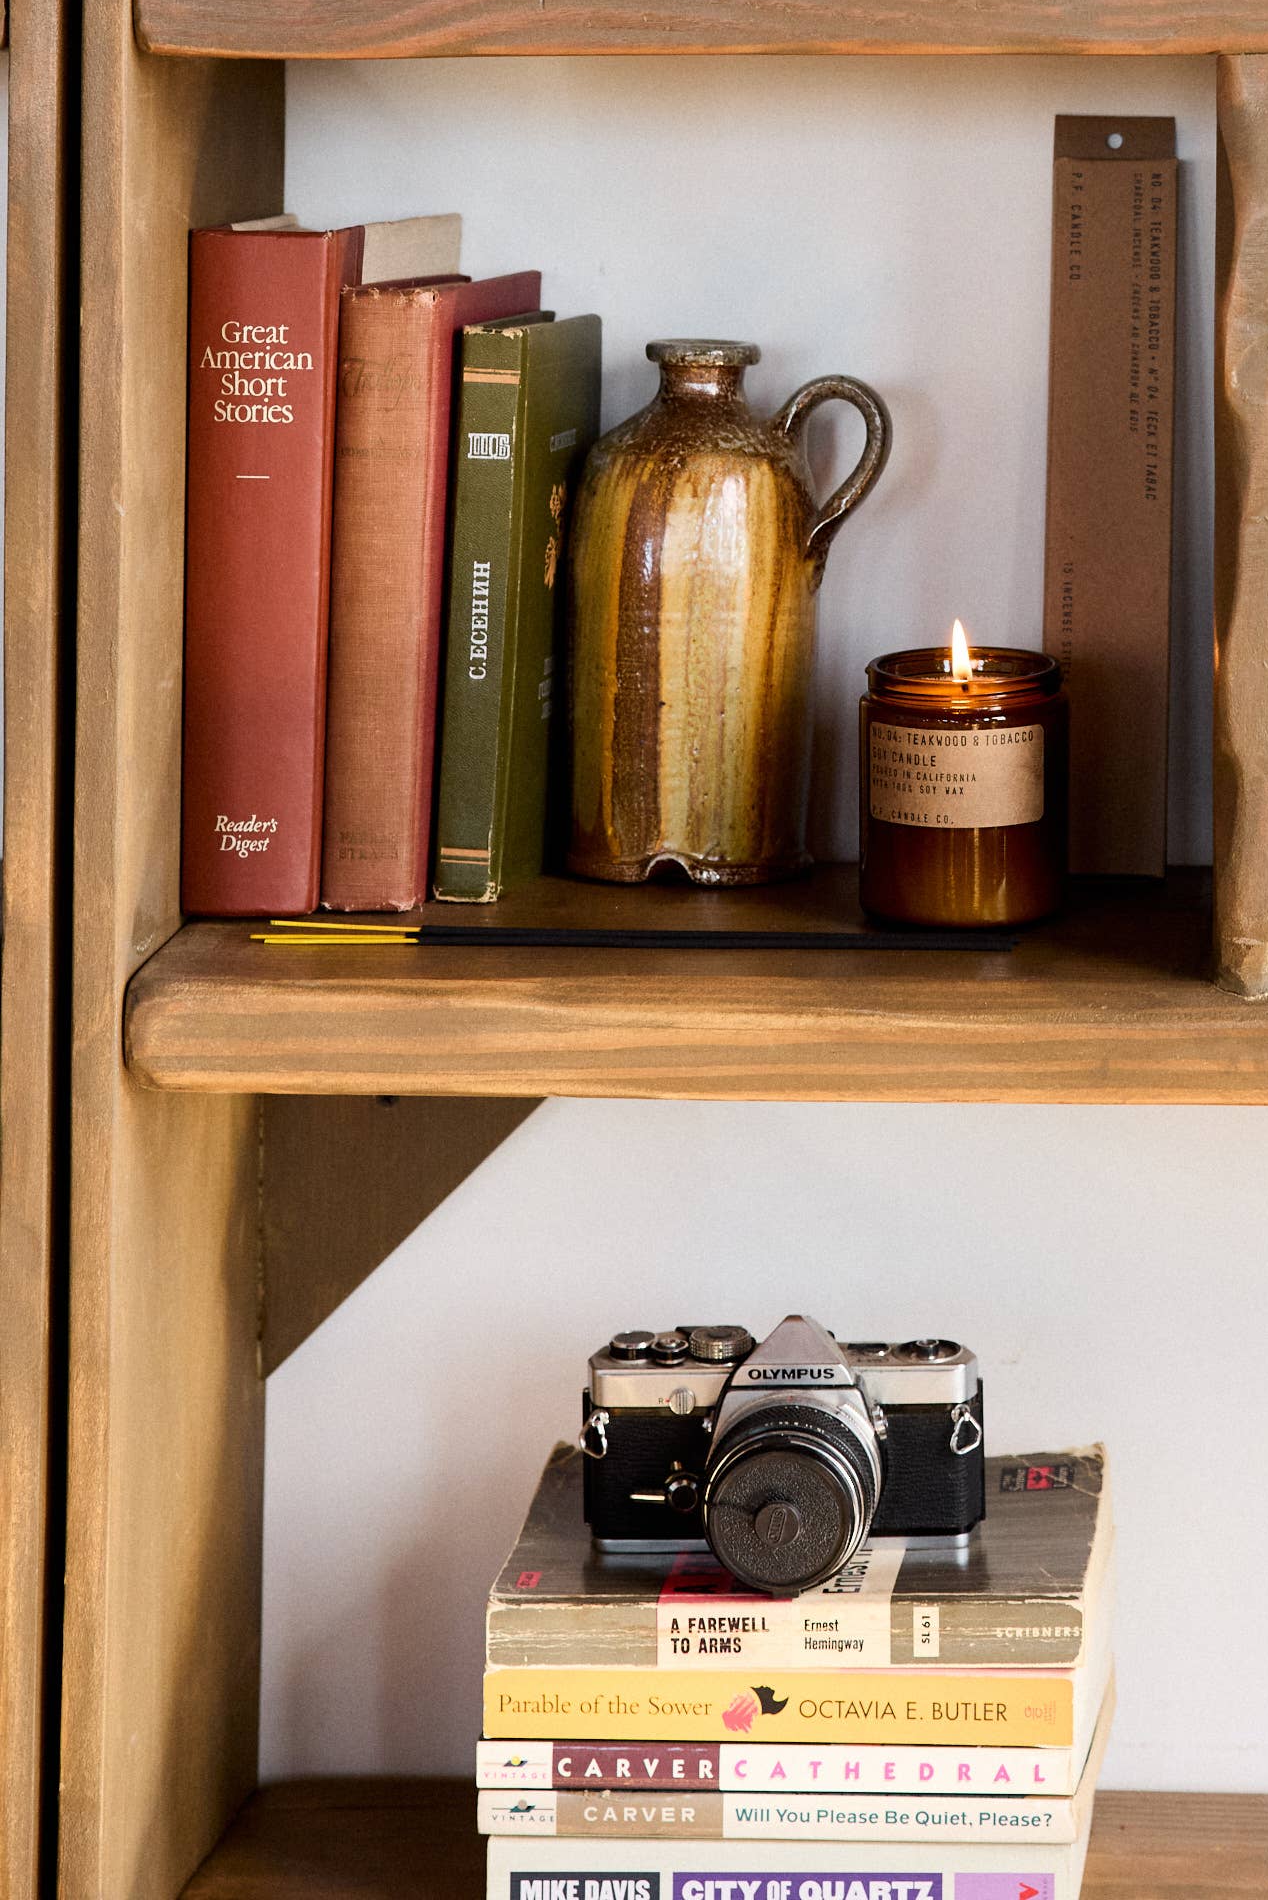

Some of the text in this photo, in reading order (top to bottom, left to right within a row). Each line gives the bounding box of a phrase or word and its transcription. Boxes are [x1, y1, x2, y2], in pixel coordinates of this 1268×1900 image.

[1070, 204, 1083, 256] CANDLE
[1150, 221, 1162, 280] TEAKWOOD
[221, 321, 289, 345] Great
[1148, 300, 1160, 351] TOBACCO
[200, 346, 314, 370] American
[221, 370, 288, 397] Short
[214, 397, 294, 424] Stories
[1145, 463, 1158, 500] TABAC
[1062, 581, 1073, 634] INCENSE
[907, 732, 967, 747] TEAKWOOD
[986, 730, 1034, 746] TOBACCO
[892, 751, 937, 767] CANDLE
[917, 772, 977, 783] CALIFORNIA
[919, 785, 937, 795] SOY
[946, 786, 964, 795] WAX
[214, 814, 278, 833] Reader's
[892, 809, 928, 823] CANDLE
[220, 834, 270, 859] Digest
[748, 1367, 835, 1382] OLYMPUS
[670, 1617, 770, 1633] A FAREWELL
[804, 1619, 839, 1632] Ernest
[996, 1626, 1080, 1638] SCRIBNERS
[670, 1637, 742, 1654] TO ARMS
[804, 1637, 865, 1652] Hemingway
[921, 1633, 931, 1644] SL
[499, 1694, 713, 1716] Parable of the Sower
[799, 1699, 897, 1720] OCTAVIA
[906, 1702, 923, 1721] E.
[932, 1702, 1007, 1722] BUTLER
[484, 1771, 548, 1781] VINTAGE
[557, 1757, 714, 1780] CARVER
[734, 1759, 1046, 1783] CATHEDRAL
[492, 1815, 555, 1823] VINTAGE
[584, 1806, 696, 1823] CARVER
[735, 1808, 1053, 1828] Will You Please Be Quiet, Please?
[520, 1879, 651, 1900] MIKE DAVIS
[682, 1880, 762, 1900] CITY
[766, 1880, 793, 1900] OF
